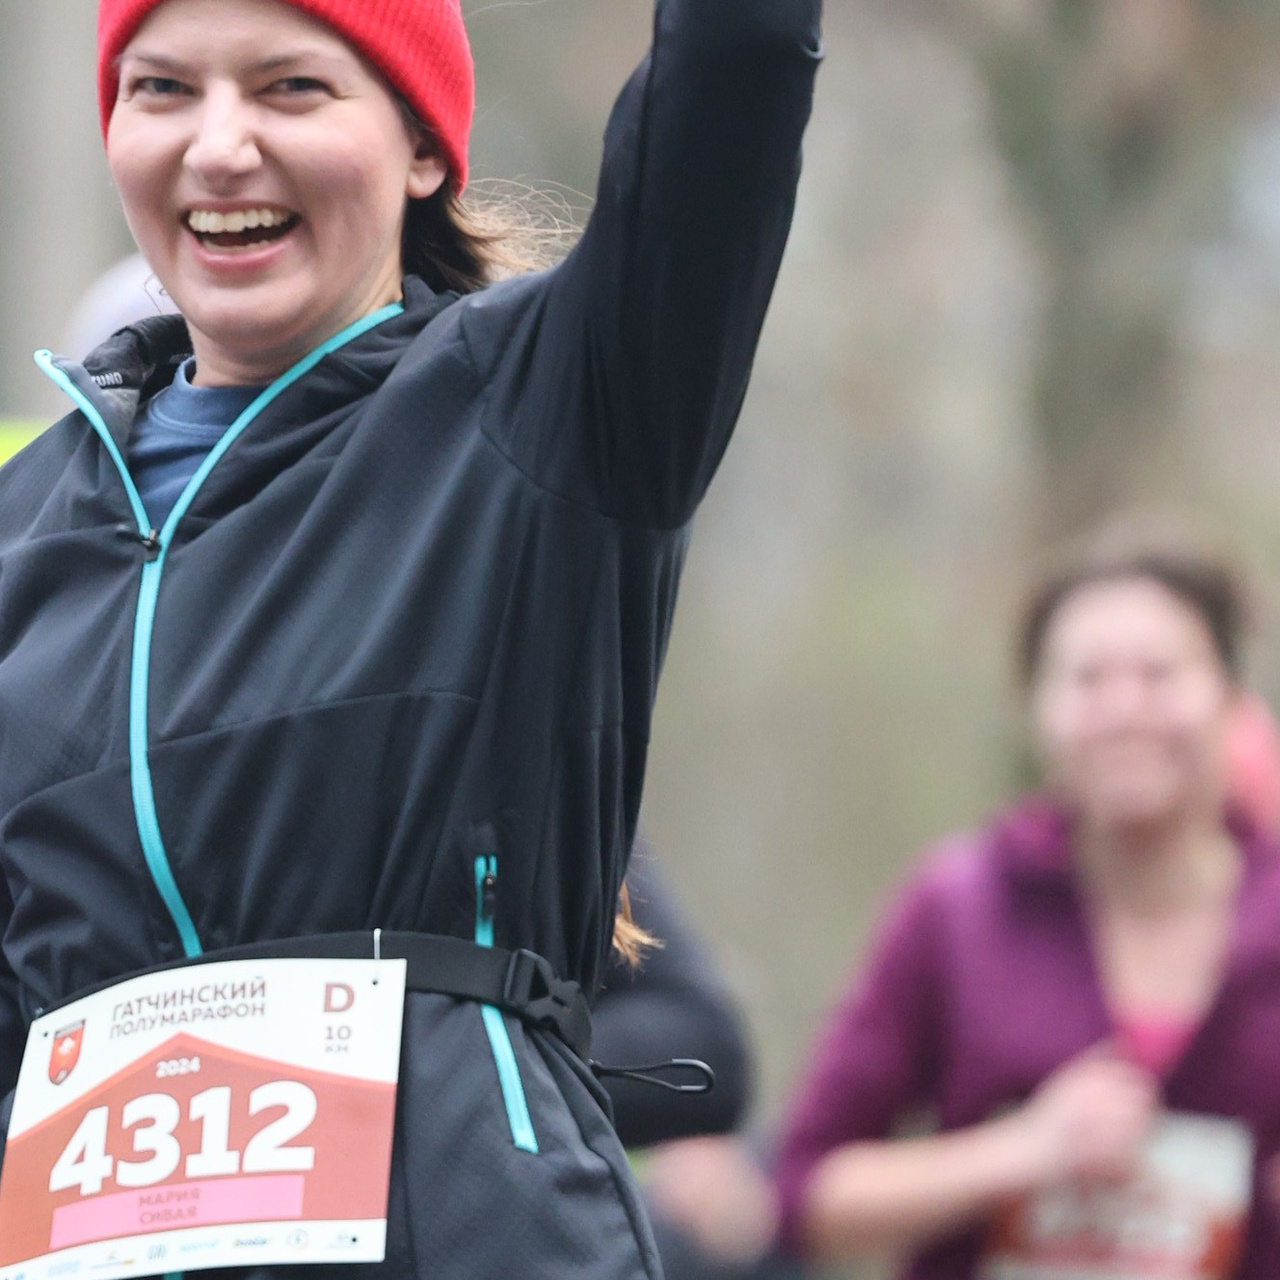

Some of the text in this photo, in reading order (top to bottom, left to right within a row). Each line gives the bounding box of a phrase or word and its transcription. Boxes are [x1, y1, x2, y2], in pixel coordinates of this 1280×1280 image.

[111, 976, 267, 1022] ГАТЧИНСКИЙ
[322, 982, 356, 1013] D
[109, 1002, 266, 1040] ПОЛУМАРАФОН
[324, 1025, 352, 1041] 10
[155, 1056, 201, 1078] 2024
[48, 1080, 318, 1196] 4312
